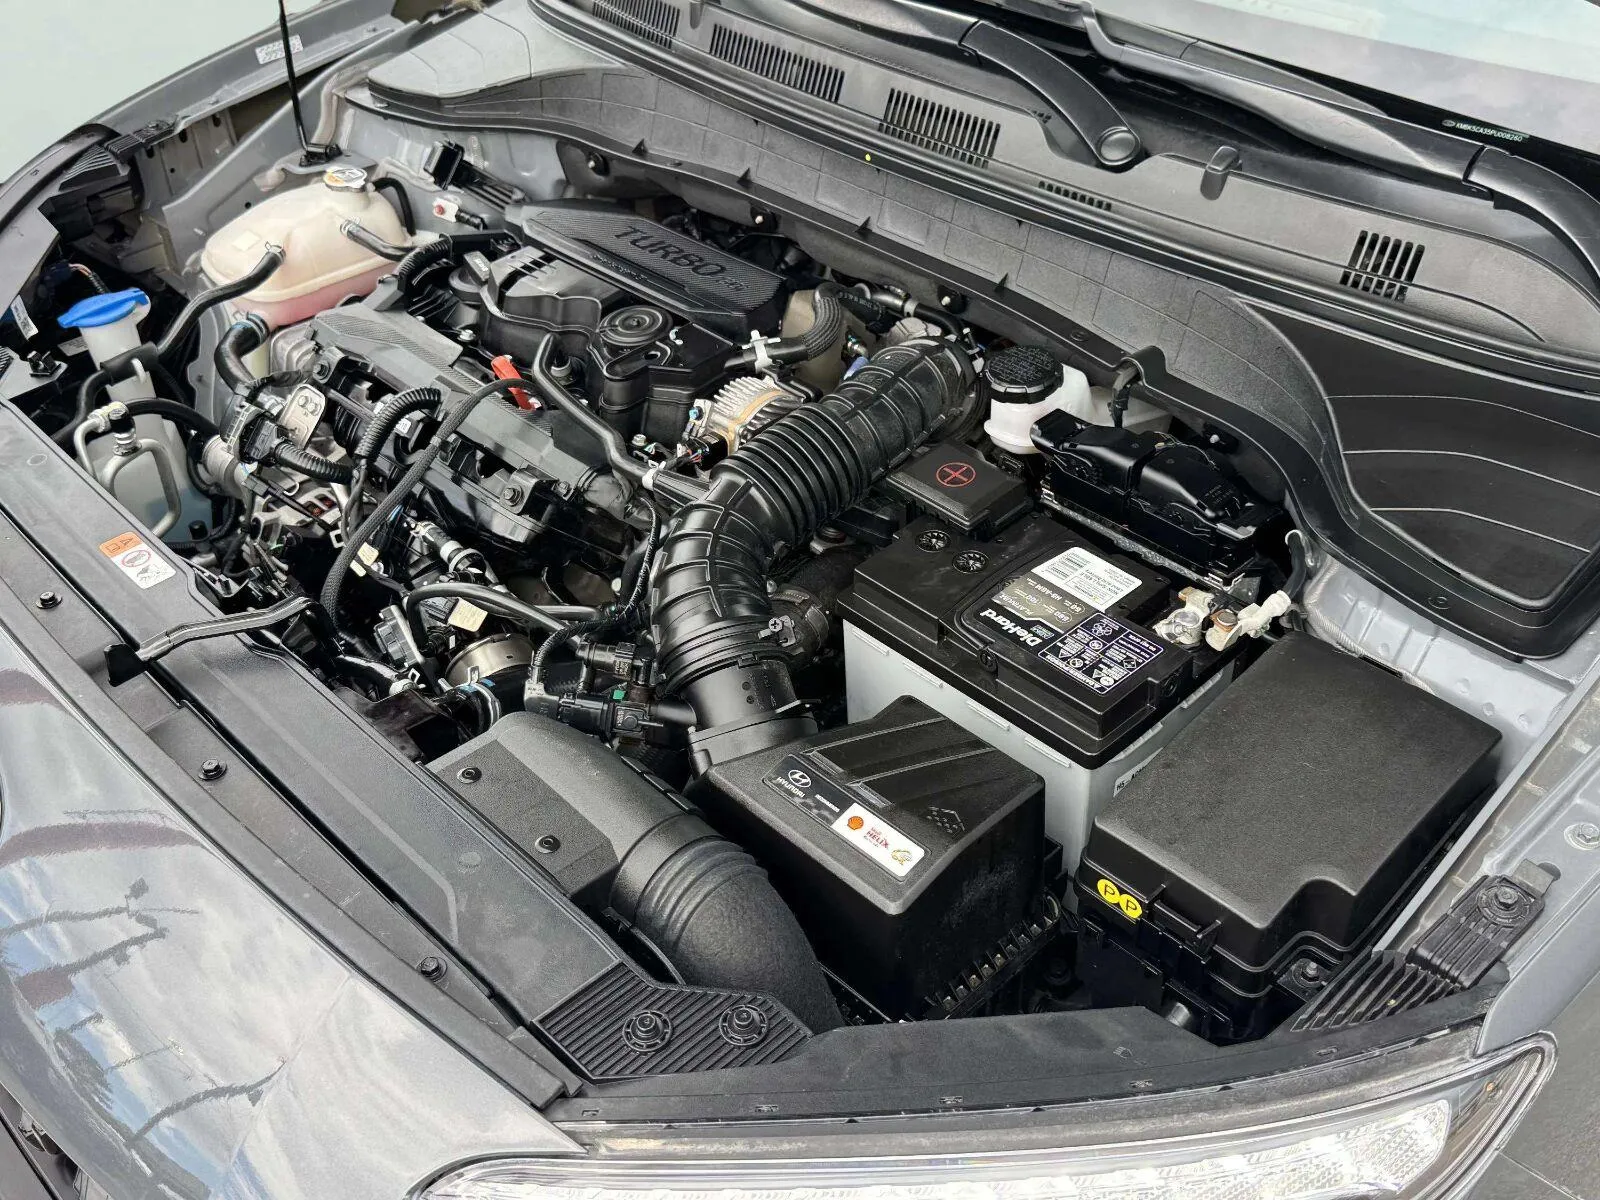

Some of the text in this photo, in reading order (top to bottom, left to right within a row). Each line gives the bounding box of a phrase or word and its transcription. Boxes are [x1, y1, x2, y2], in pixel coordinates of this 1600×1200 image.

[614, 225, 726, 277] TURBO
[978, 607, 1043, 647] DieHard
[776, 776, 806, 798] HYUNDAI
[866, 830, 889, 849] HELIX
